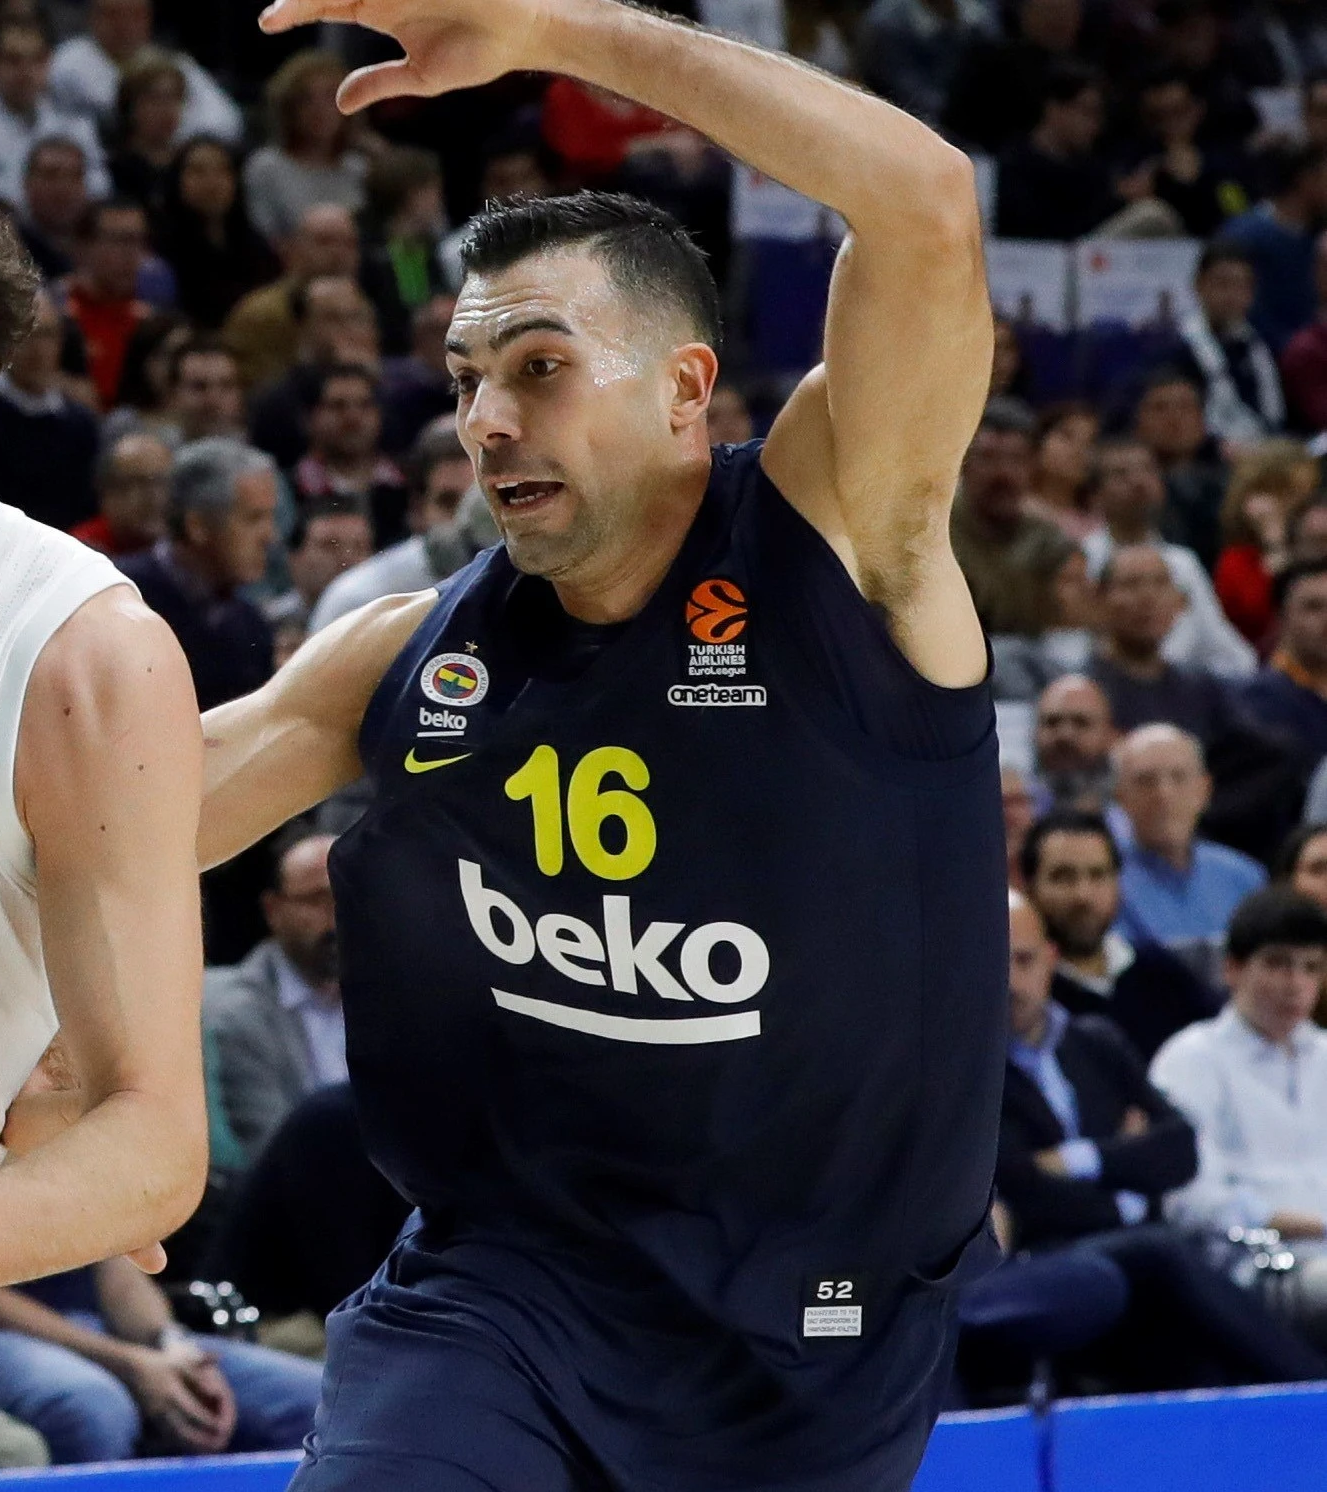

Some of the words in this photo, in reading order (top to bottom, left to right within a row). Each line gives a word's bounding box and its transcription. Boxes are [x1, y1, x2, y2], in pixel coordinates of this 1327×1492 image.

[688, 644, 746, 655] TURKISH
[688, 655, 746, 666] AIRLINES
[688, 667, 746, 677] EuroLeague
[670, 685, 765, 703] oneteam
[419, 707, 467, 730] beko
[504, 744, 657, 880] 16
[458, 858, 770, 1004] beko
[816, 1281, 853, 1300] 52
